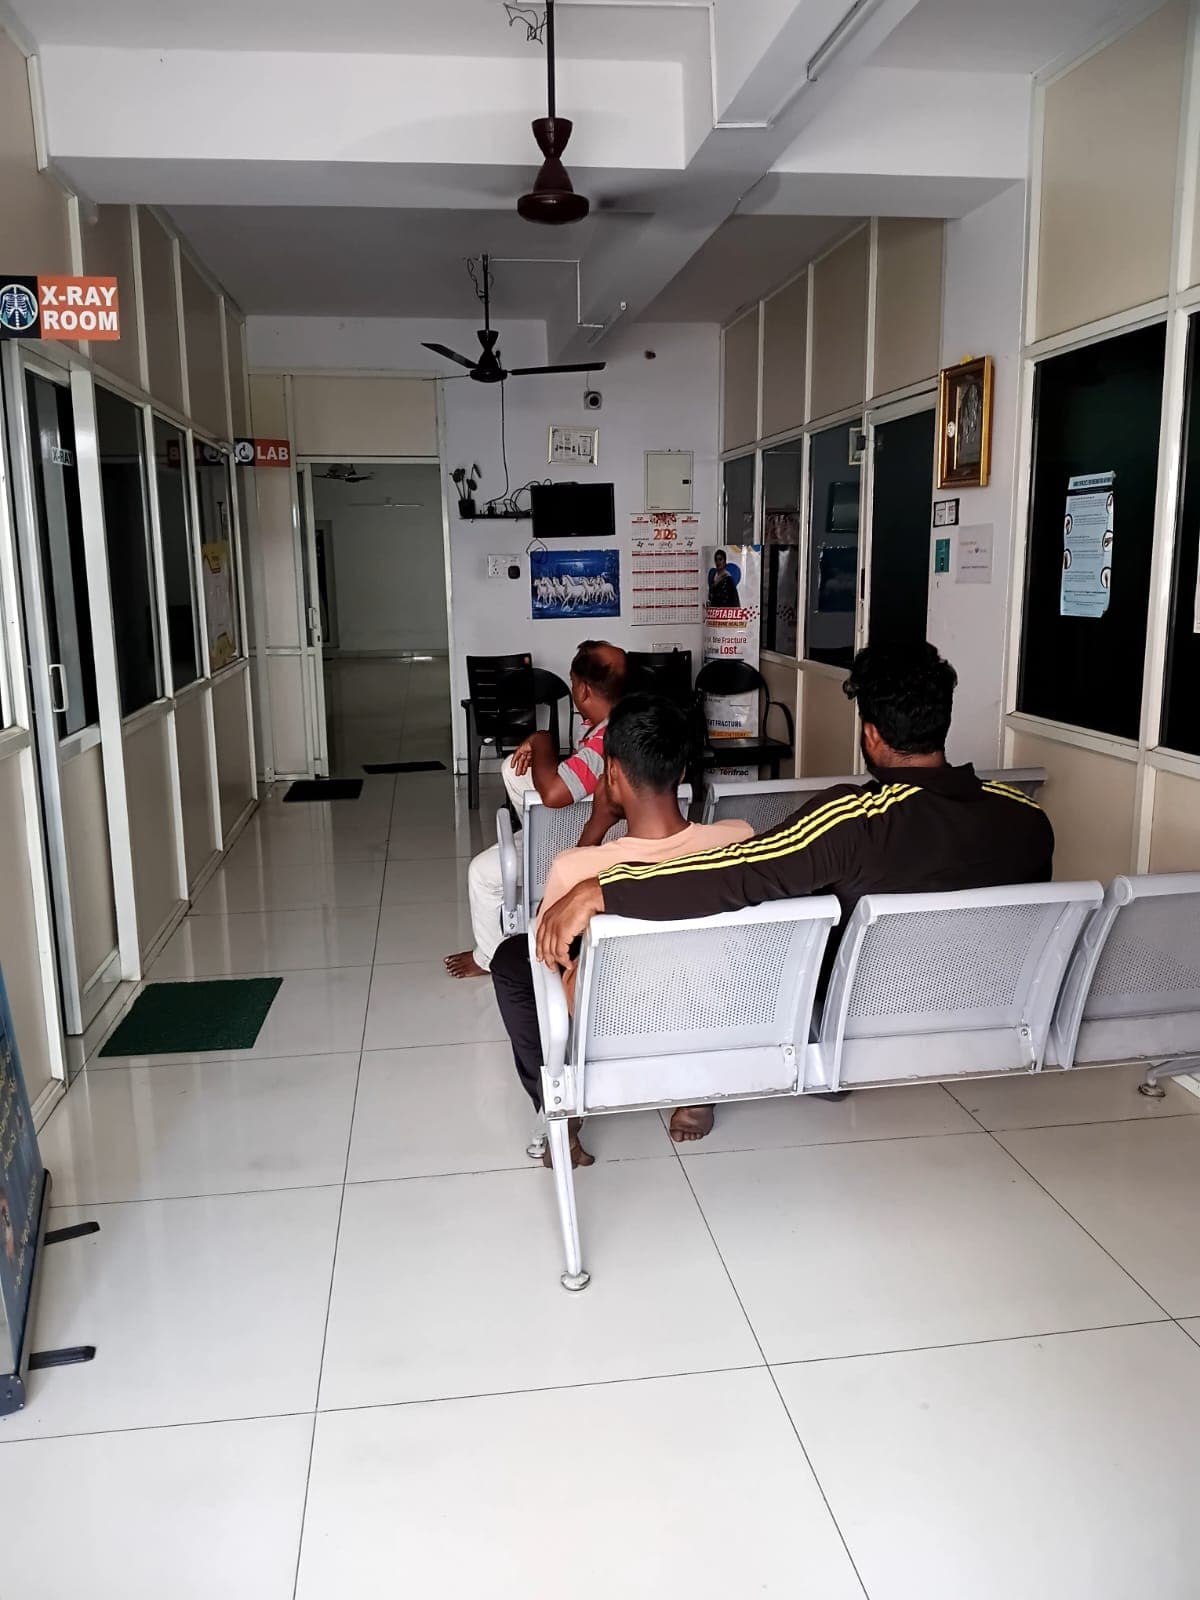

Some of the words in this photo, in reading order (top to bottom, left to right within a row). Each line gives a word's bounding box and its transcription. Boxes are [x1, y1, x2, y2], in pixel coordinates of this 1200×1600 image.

[41, 286, 117, 307] X-RAY
[43, 310, 118, 331] ROOM
[52, 448, 73, 464] X-RAY
[257, 446, 289, 460] LAB
[654, 529, 678, 540] 2026
